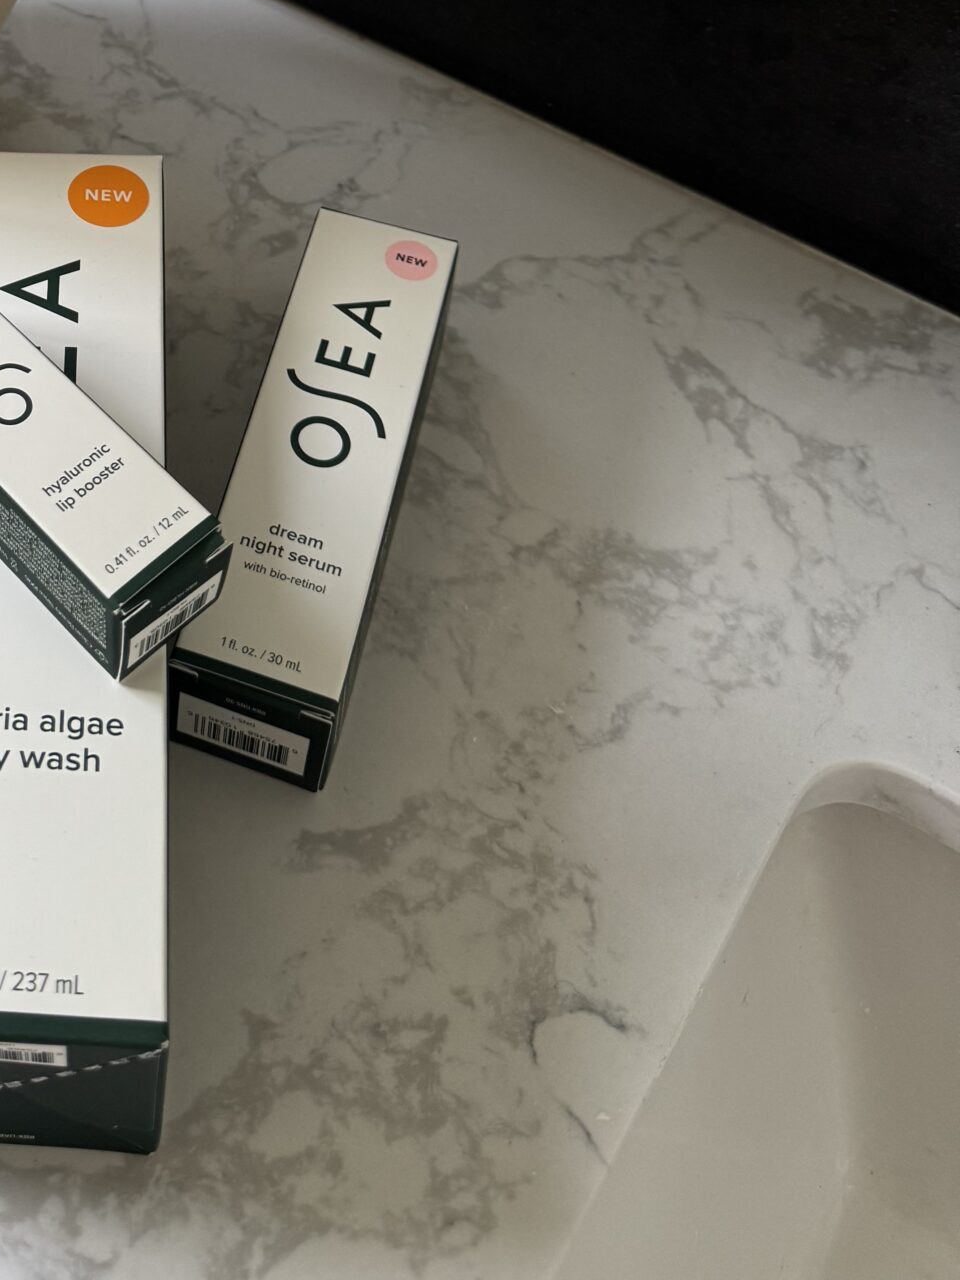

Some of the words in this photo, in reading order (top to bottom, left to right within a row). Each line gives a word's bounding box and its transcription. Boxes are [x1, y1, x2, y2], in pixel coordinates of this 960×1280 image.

[85, 188, 133, 202] NEW
[396, 253, 428, 267] NEW
[287, 300, 392, 468] OSEA
[41, 444, 111, 497] hyaluronic
[55, 495, 76, 512] lip
[73, 457, 125, 498] booster
[104, 553, 128, 574] 0.41
[125, 546, 139, 558] fl.
[138, 535, 156, 548] oz.
[152, 525, 160, 536] /
[158, 517, 173, 531] 12
[171, 506, 189, 521] mL
[269, 524, 324, 550] dream
[239, 535, 285, 558] night
[287, 551, 343, 577] serum
[243, 560, 267, 575] with
[269, 568, 327, 594] bio-retinol
[221, 636, 227, 646] 1
[228, 639, 238, 651] fl.
[241, 645, 257, 658] oz.
[259, 650, 267, 659] /
[267, 652, 283, 666] 30
[285, 659, 302, 673] mL
[39, 709, 124, 740] algae
[19, 747, 101, 772] wash
[11, 971, 50, 992] 237
[55, 974, 85, 995] mL
